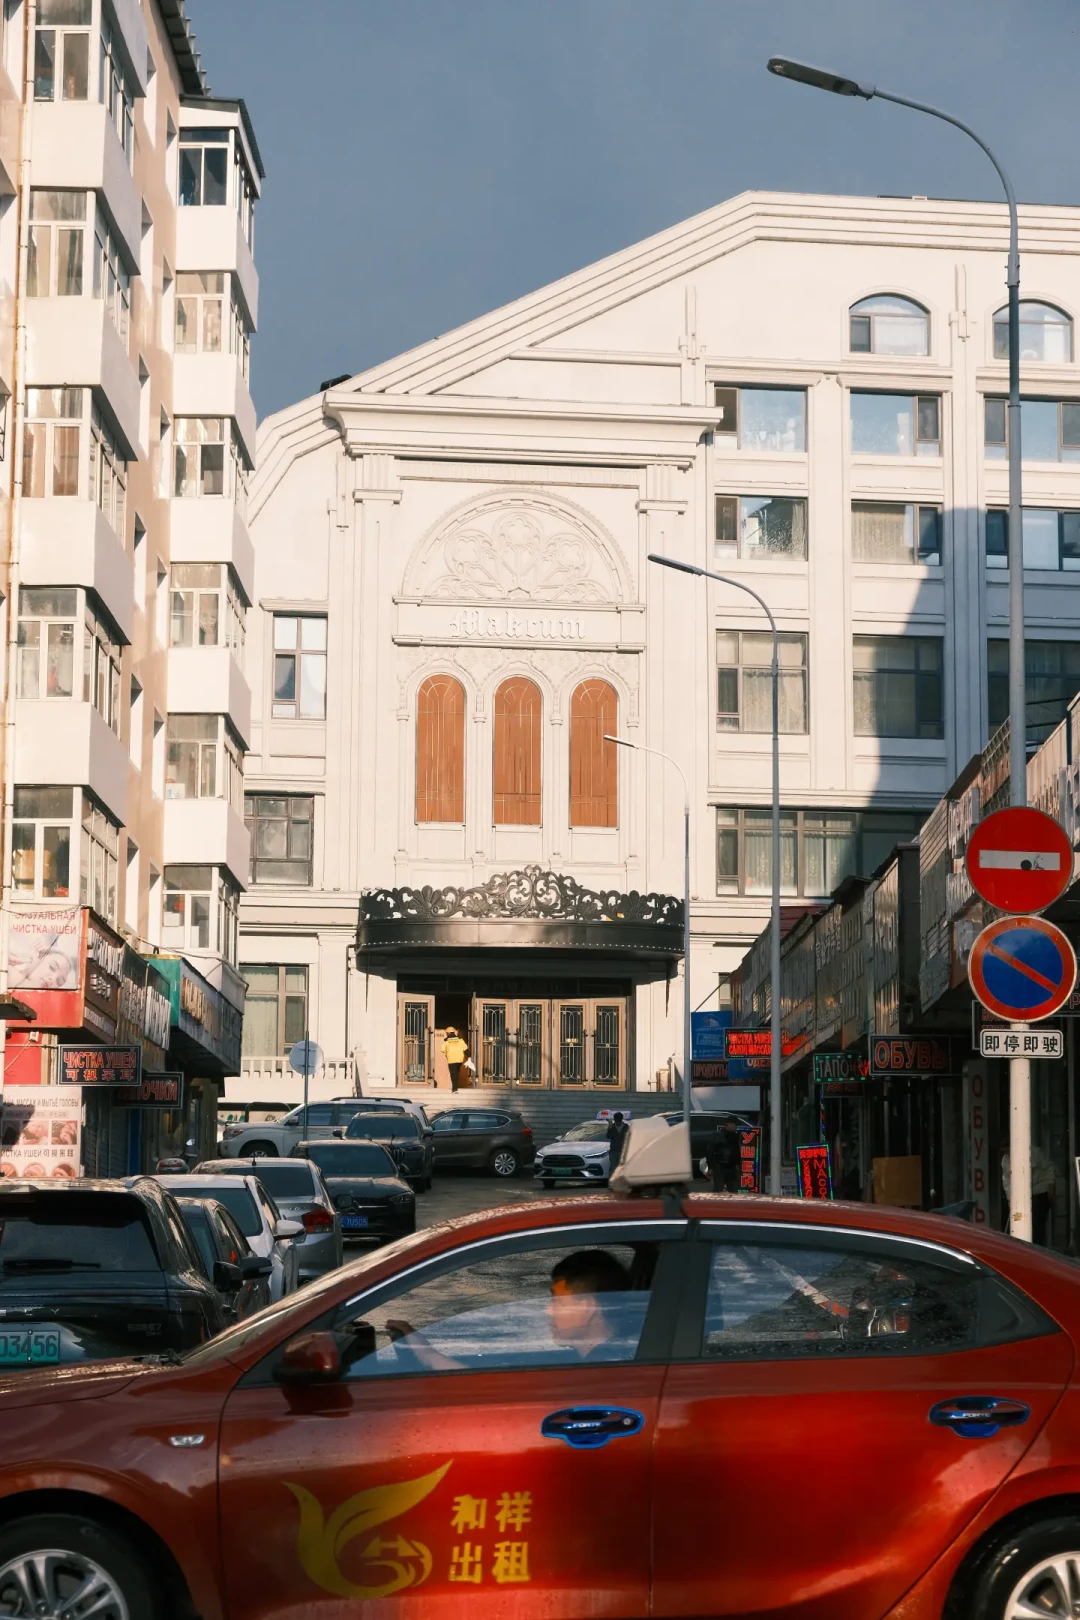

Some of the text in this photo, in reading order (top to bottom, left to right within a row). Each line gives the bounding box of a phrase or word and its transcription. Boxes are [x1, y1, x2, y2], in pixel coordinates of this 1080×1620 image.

[13, 923, 77, 935] ЧИСТКА УШЕЙ
[874, 1040, 947, 1069] ОБУВЬ
[984, 1035, 1059, 1053] 即停即驶
[63, 1047, 136, 1069] ЧИСТКА УШЕЙ
[66, 1069, 134, 1081] 可视采耳
[24, 1148, 42, 1158] УШЕЙ
[741, 1131, 755, 1188] УШЕЙ
[450, 1491, 533, 1534] 和祥
[448, 1541, 531, 1584] 出租
